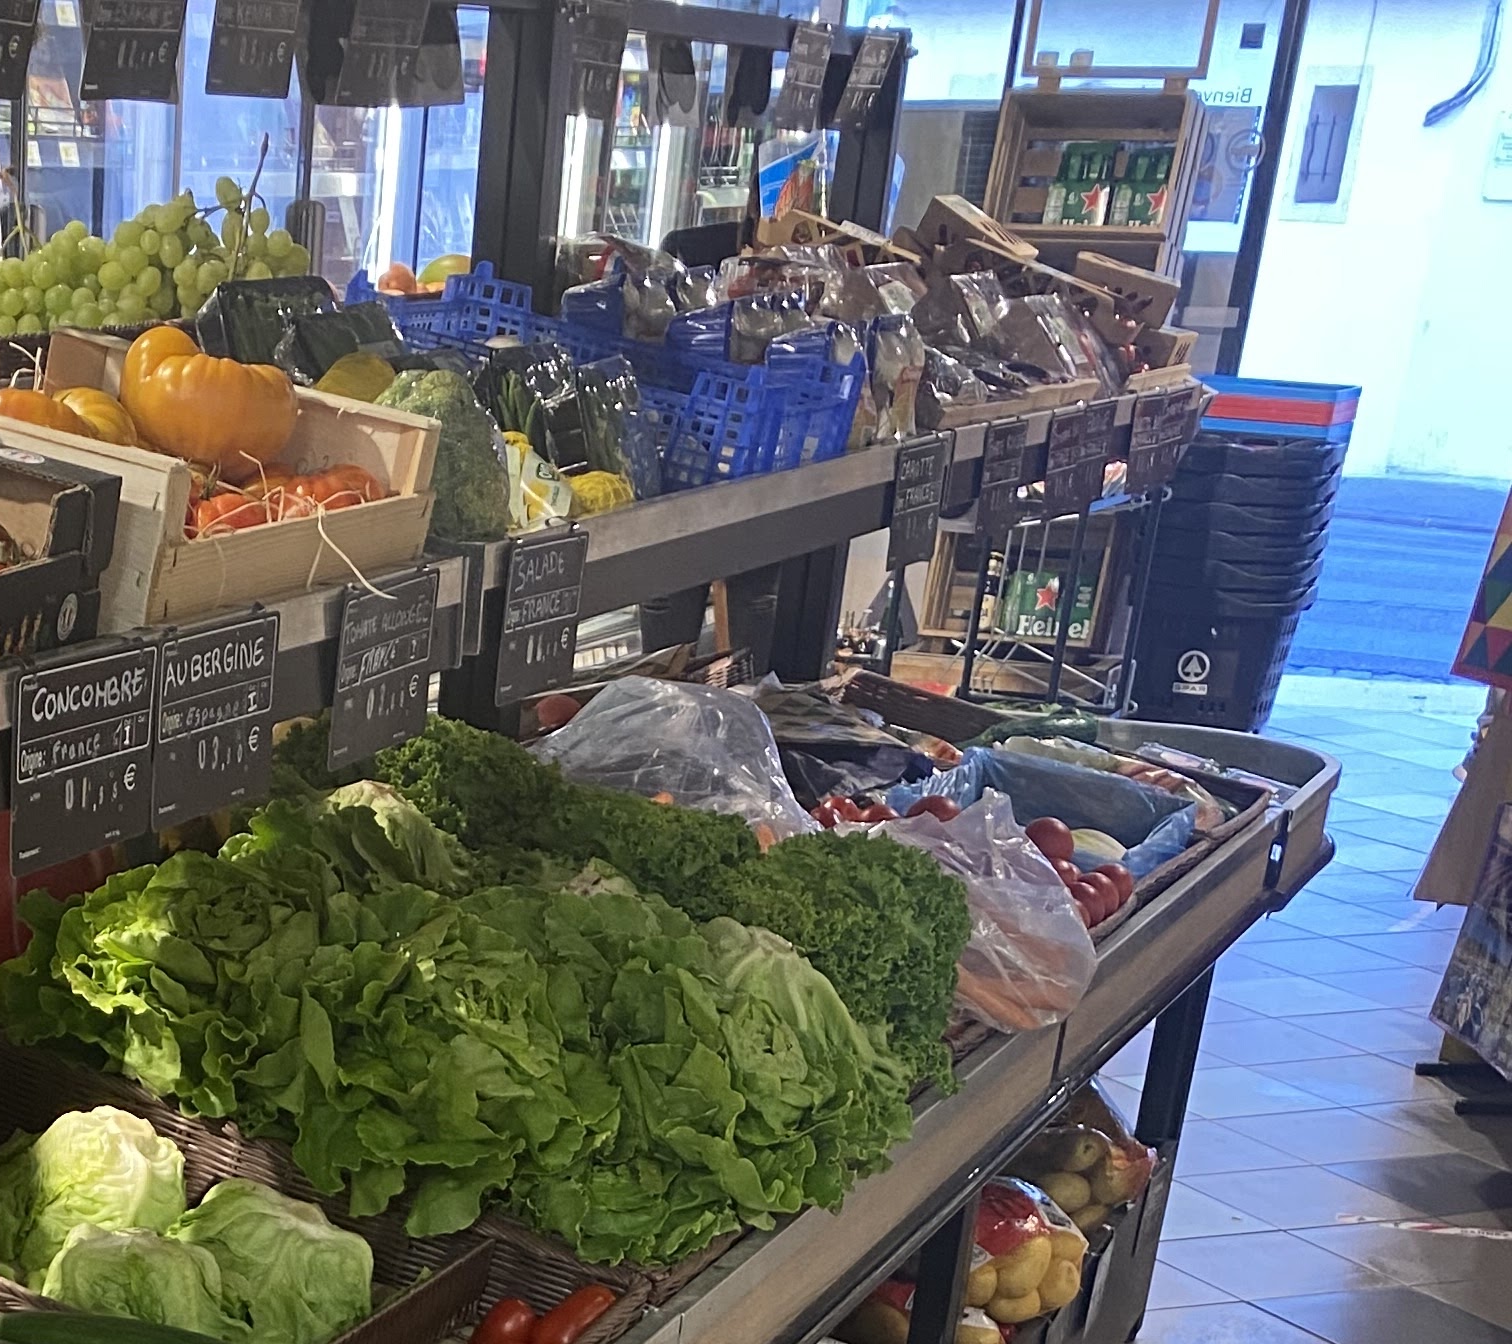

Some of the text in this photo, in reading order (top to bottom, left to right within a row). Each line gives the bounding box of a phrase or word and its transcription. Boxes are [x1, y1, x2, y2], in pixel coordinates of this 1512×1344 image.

[514, 551, 565, 593] SALADE
[521, 590, 561, 622] FRANCE
[163, 636, 265, 697] AUBERGINE
[31, 666, 146, 722] CONCOMBRE
[409, 674, 420, 698] €
[185, 700, 240, 727] Espagne
[51, 732, 101, 767] France
[248, 726, 261, 752] €
[123, 763, 137, 791] €
